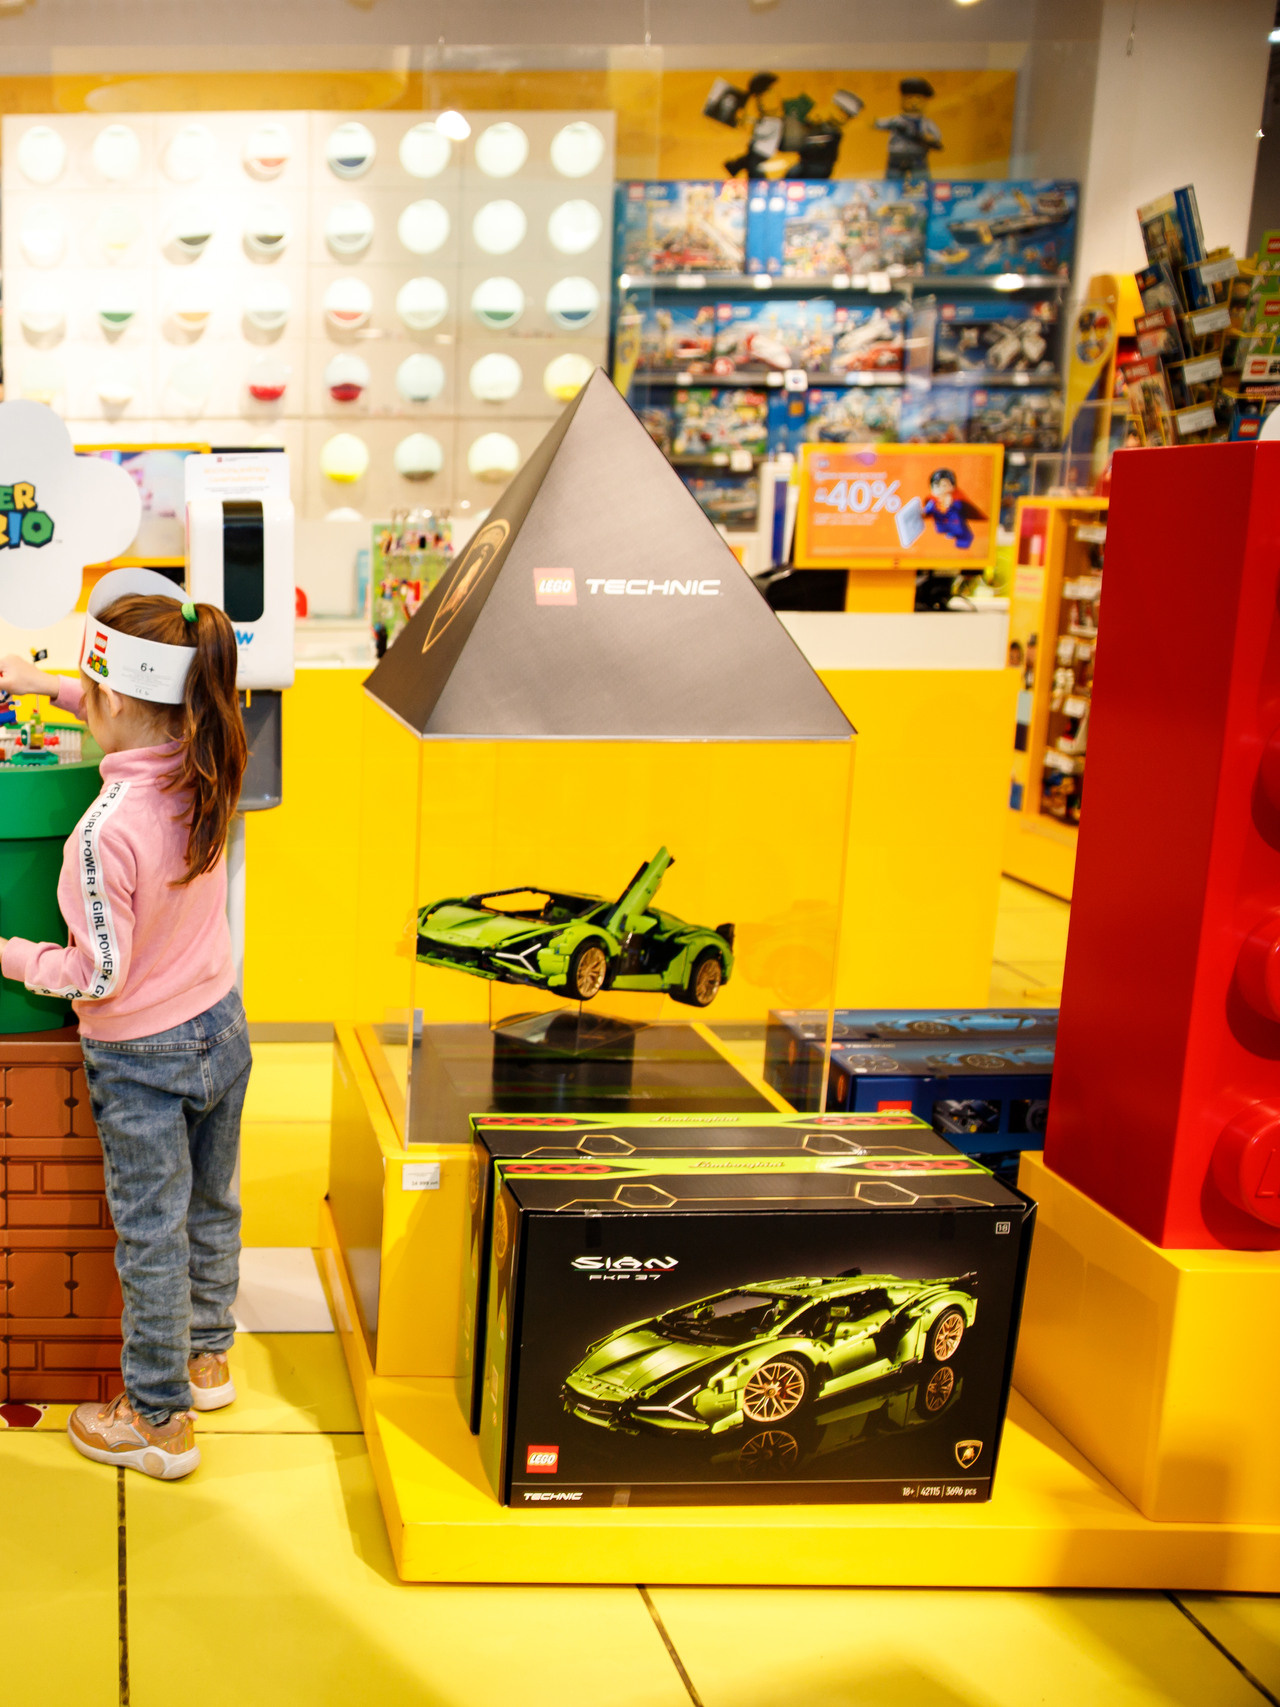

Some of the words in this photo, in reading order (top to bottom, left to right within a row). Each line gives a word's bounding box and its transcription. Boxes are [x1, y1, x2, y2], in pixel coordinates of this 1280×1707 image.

[538, 578, 572, 594] LEGO
[585, 578, 721, 595] TECHNIC
[87, 656, 109, 678] MARIO
[83, 811, 102, 836] GIRL
[84, 840, 96, 885] POWER
[92, 901, 105, 930] GIRL
[98, 933, 113, 976] POWER
[528, 1453, 557, 1465] LEGO
[523, 1492, 583, 1501] TECHNIC
[902, 1486, 915, 1497] 18+
[920, 1486, 940, 1497] 42115
[964, 1488, 977, 1498] pcs
